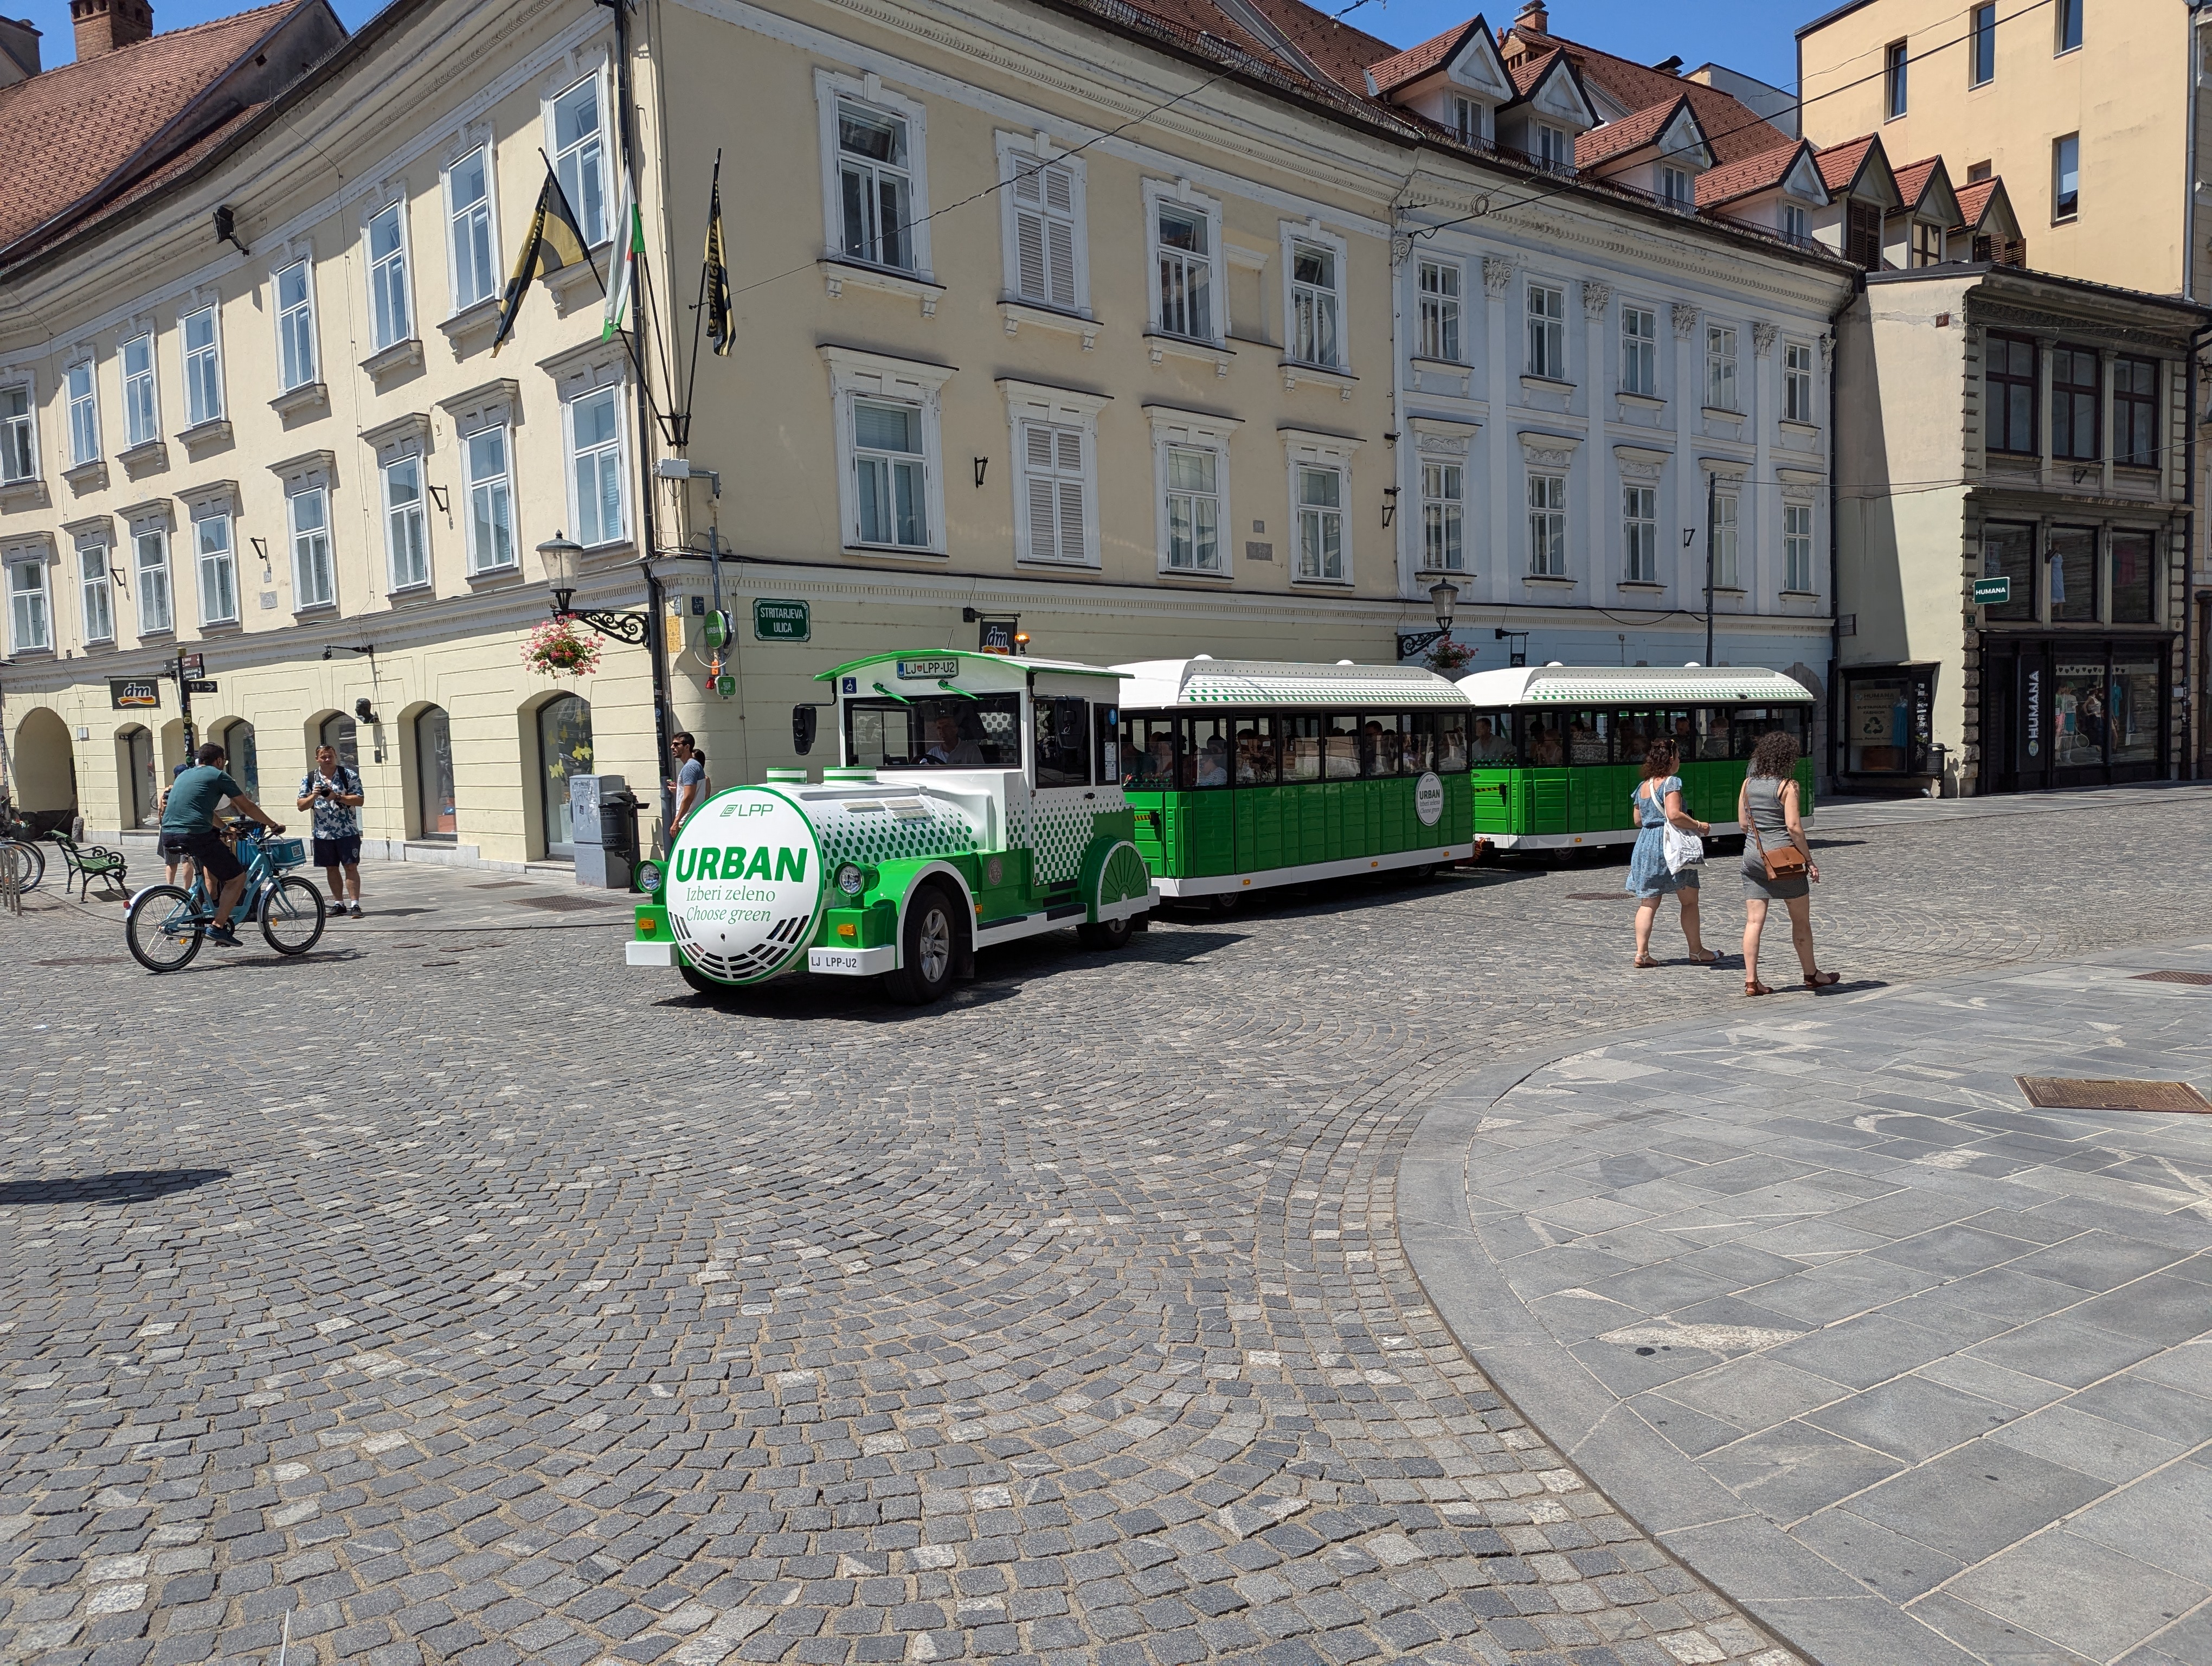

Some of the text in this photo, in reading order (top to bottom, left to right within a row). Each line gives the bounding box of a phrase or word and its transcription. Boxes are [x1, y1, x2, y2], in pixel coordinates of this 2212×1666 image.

[1976, 587, 2006, 595] HUMANA
[760, 607, 803, 619] STRITARJEVA
[706, 626, 722, 635] URBAN
[773, 622, 793, 633] ULICA
[987, 626, 1008, 647] dm
[905, 662, 955, 674] LJ LPP-U2
[124, 683, 151, 697] dm
[2028, 670, 2039, 739] HUMANA
[1419, 789, 1441, 800] URBAN
[738, 804, 774, 817] LPP
[676, 847, 808, 883] URBAN
[686, 885, 776, 902] Izberi zeleno
[686, 906, 771, 925] Choose green
[811, 956, 857, 968] LJ LPP-U2
